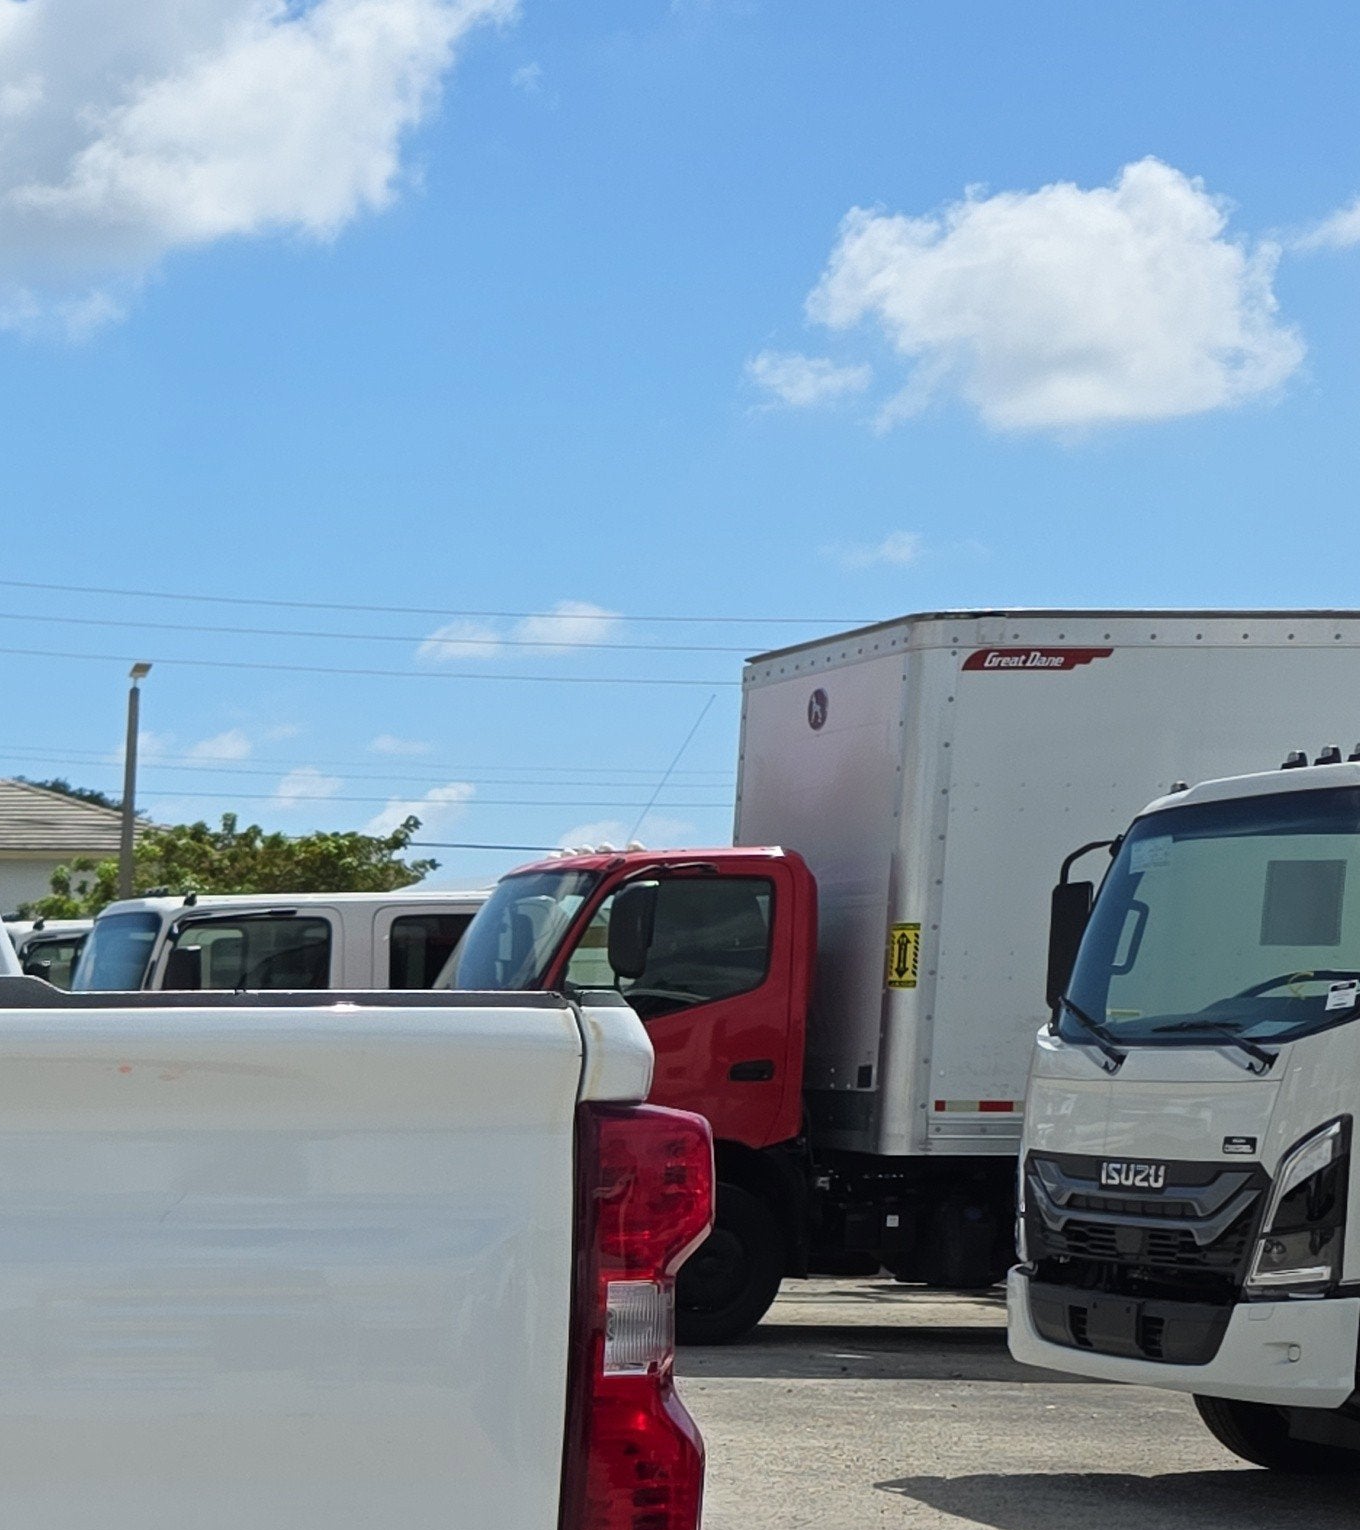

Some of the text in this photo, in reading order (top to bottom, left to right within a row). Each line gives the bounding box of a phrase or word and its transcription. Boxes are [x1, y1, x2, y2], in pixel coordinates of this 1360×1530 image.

[983, 651, 1065, 667] Great Dane
[1100, 1161, 1167, 1188] ISUZU
